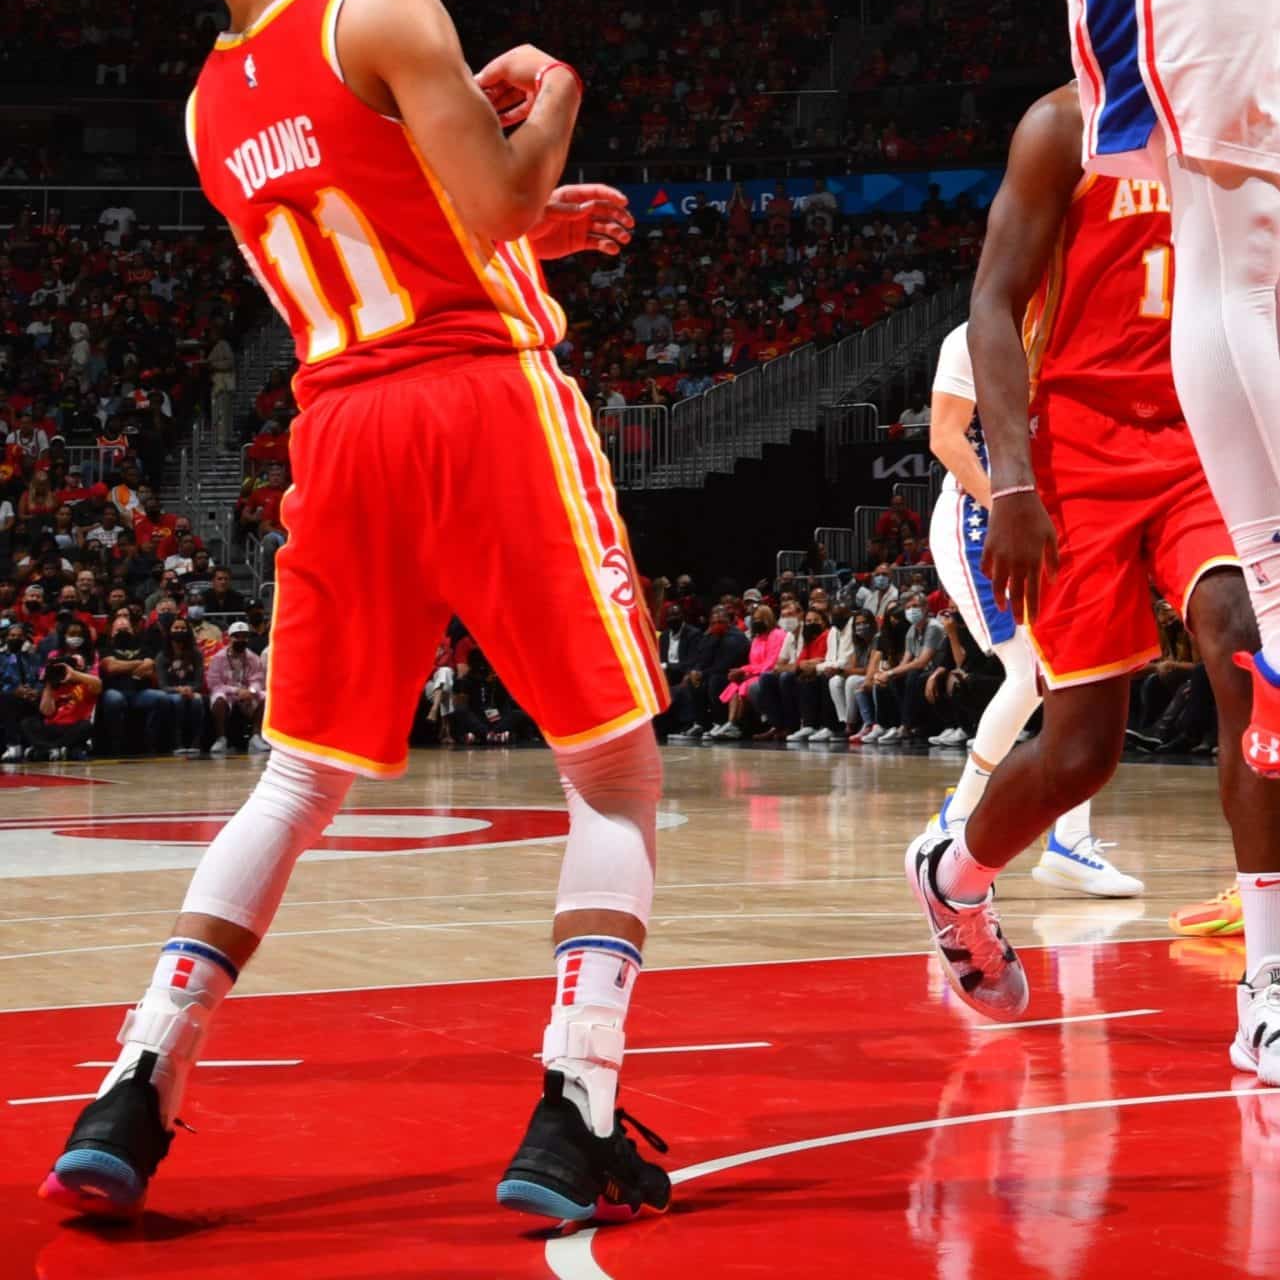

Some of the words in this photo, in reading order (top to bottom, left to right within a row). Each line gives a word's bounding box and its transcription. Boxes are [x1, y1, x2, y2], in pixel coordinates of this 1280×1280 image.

[223, 114, 321, 199] YOUNG
[259, 186, 415, 365] 11
[1138, 244, 1171, 320] 1
